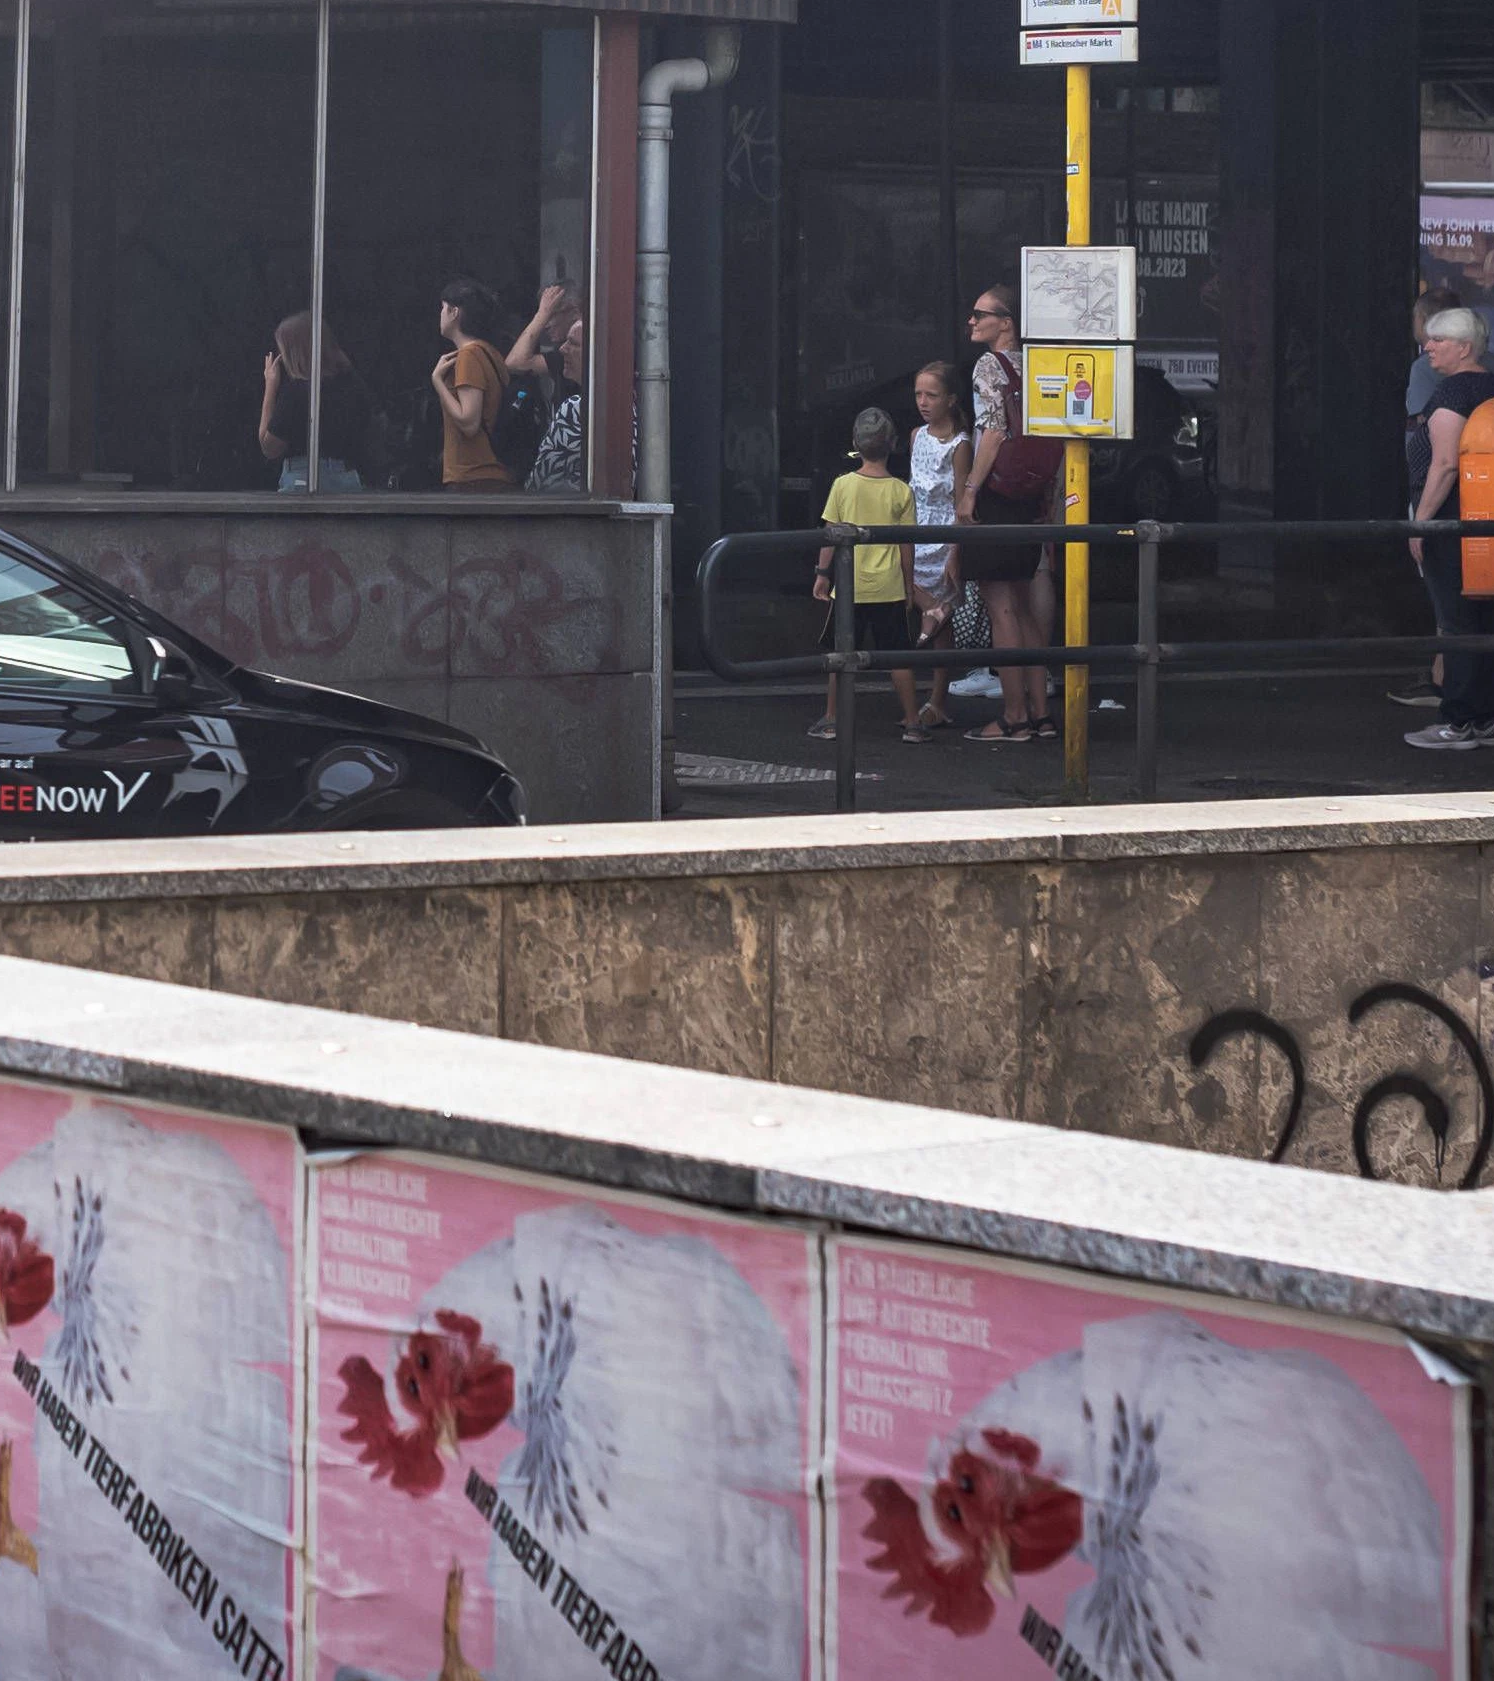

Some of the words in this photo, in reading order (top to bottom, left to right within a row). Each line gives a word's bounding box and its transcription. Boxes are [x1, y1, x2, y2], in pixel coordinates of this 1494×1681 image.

[1089, 38, 1113, 48] Markt
[1163, 201, 1209, 227] NACHT
[1444, 220, 1476, 233] JOHN
[1148, 229, 1210, 255] MUSEEN
[14, 756, 35, 770] auf
[36, 1378, 87, 1460] HABEN
[83, 1434, 220, 1622] TIERFABRIKEN
[492, 1498, 556, 1594] HABEN
